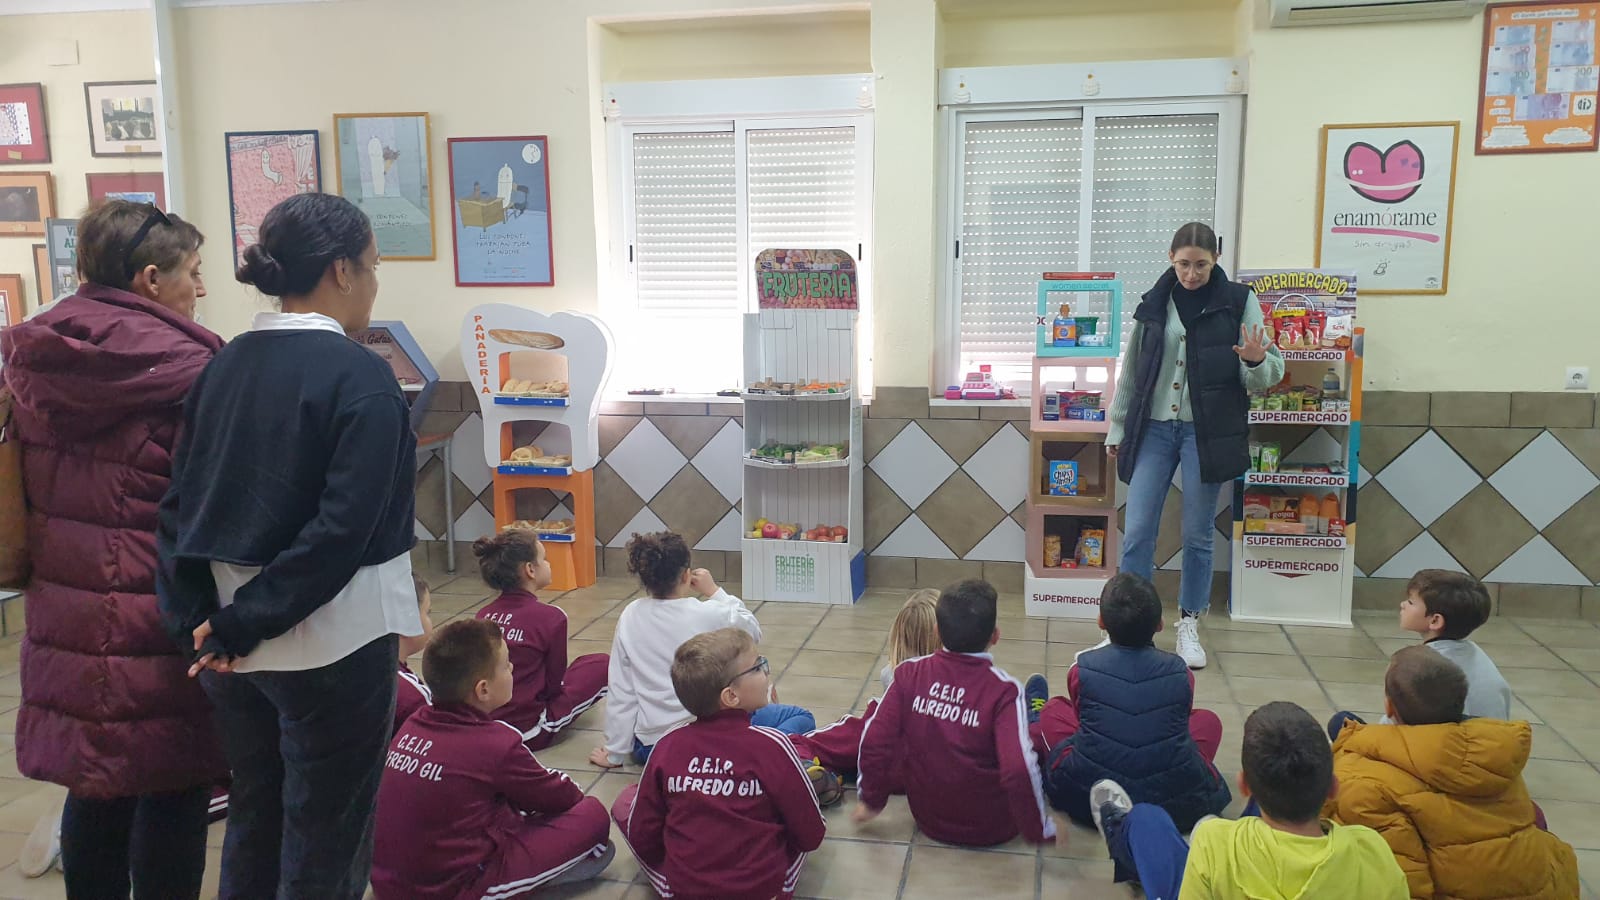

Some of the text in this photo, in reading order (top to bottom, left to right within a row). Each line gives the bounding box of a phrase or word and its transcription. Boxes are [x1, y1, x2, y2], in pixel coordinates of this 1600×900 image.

[1334, 207, 1437, 226] enamórame
[763, 264, 852, 299] FRUTERÍA
[1281, 351, 1343, 360] ERMERCADO
[1250, 412, 1347, 422] SUPERMERCADO
[1249, 474, 1345, 486] SUPERMERCADO
[1246, 536, 1342, 547] SUPERMERCADO
[1245, 559, 1339, 572] SUPERMERCADO
[1032, 593, 1101, 606] SUPERMERCAD
[506, 628, 524, 642] GIL
[929, 682, 965, 704] C.E.I.P.
[397, 733, 433, 757] C.E.I.P.
[385, 751, 443, 781] FREDO GIL
[688, 756, 734, 775] C.E.I.P.
[667, 775, 763, 796] ALFREDO GIL
